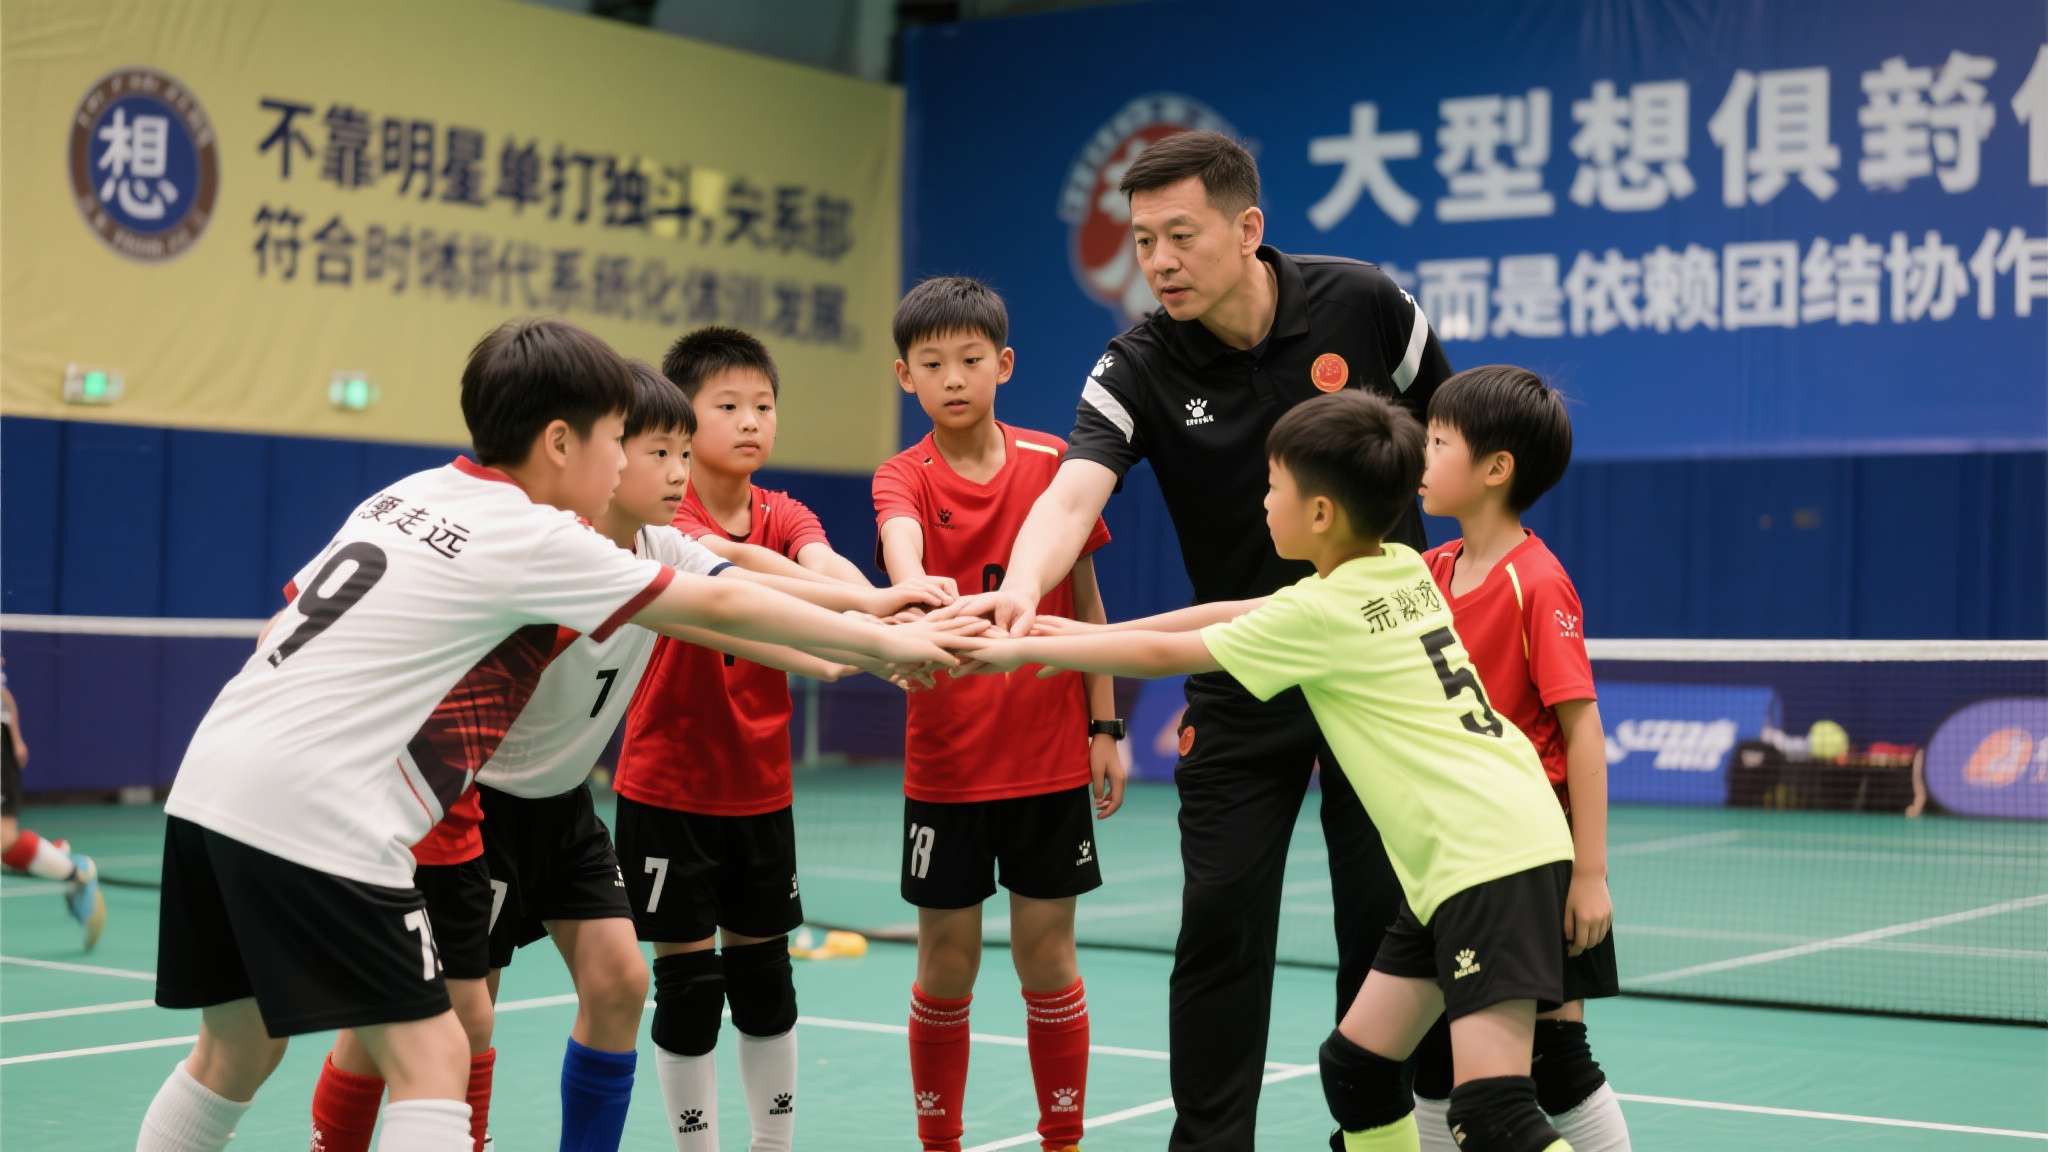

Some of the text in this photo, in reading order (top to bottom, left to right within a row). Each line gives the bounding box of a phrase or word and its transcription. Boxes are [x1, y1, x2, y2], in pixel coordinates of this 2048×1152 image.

[97, 106, 179, 221] 想
[1378, 227, 2048, 342] 而是依赖团结协作
[267, 541, 388, 669] 9
[1420, 625, 1504, 738] 5
[644, 857, 669, 913] 7
